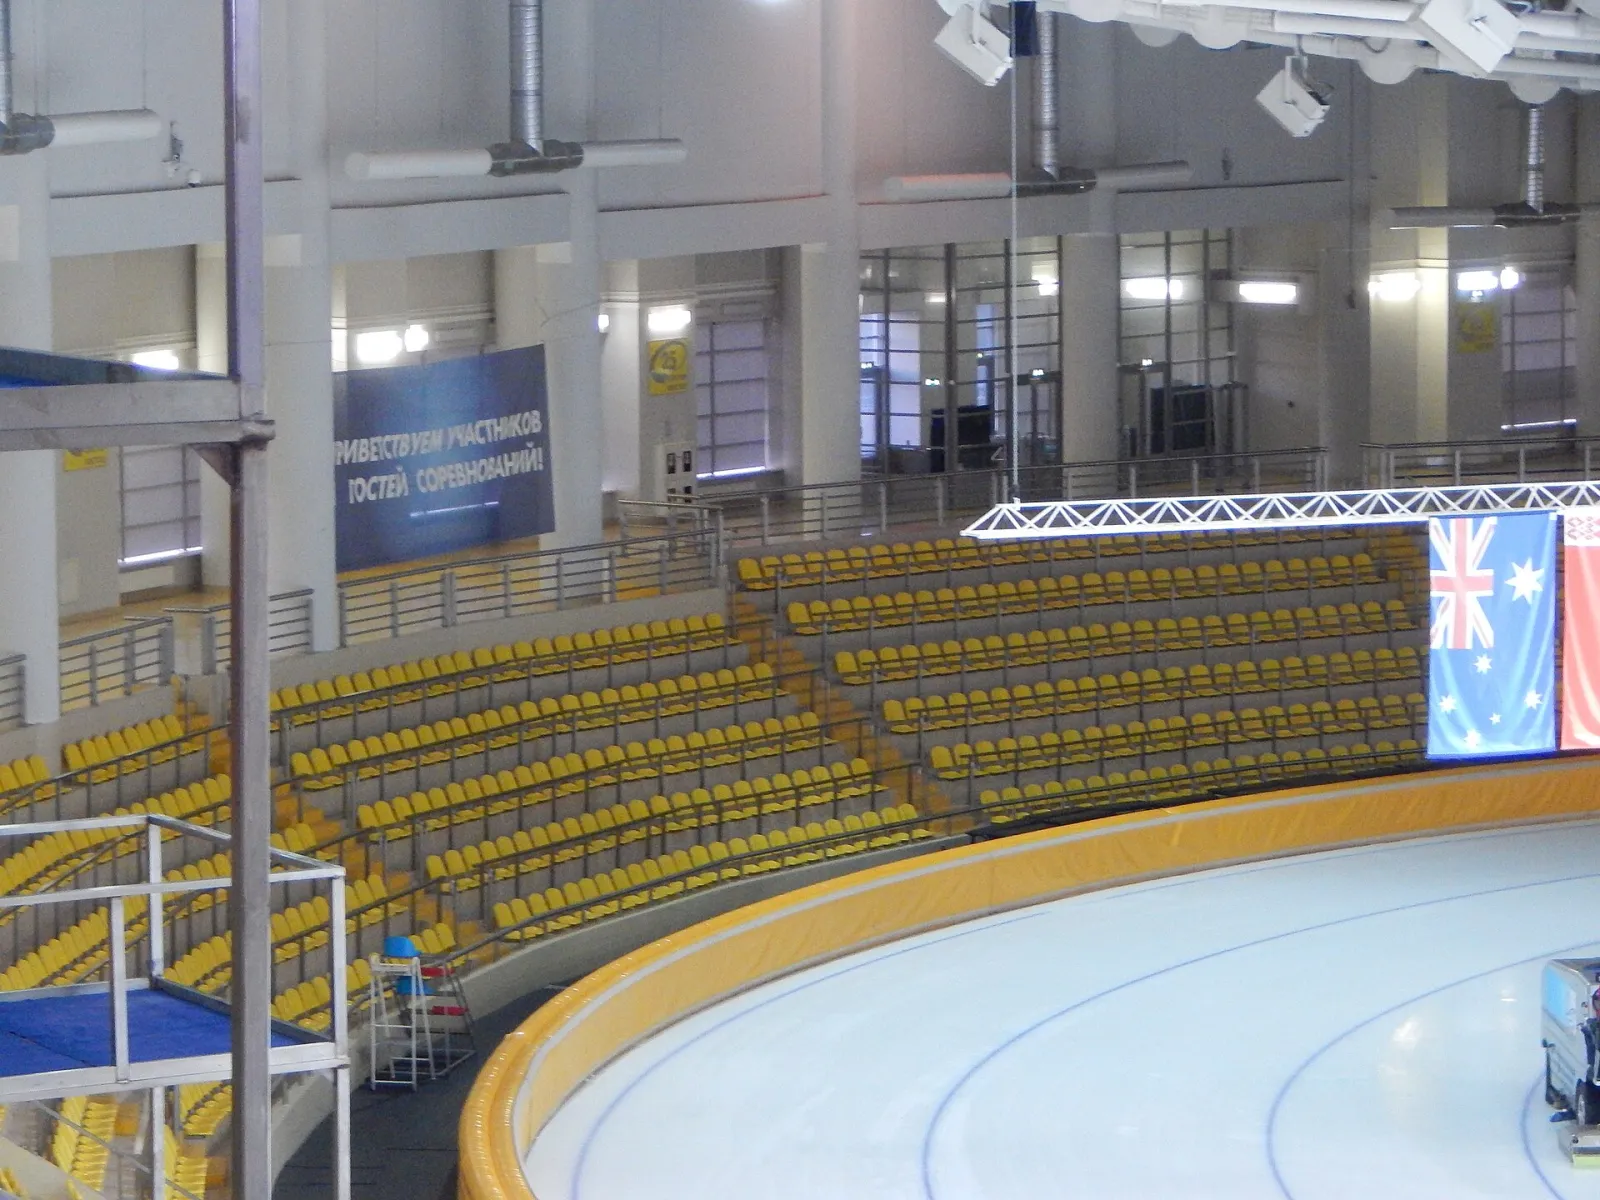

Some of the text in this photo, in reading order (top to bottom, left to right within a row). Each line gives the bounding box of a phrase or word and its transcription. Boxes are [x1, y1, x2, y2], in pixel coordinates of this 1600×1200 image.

[333, 410, 542, 465] РИВЕТСТВУЕМ УЧАСТНИКОВ
[348, 441, 544, 504] ГОСТЕЙ СОРЕВНОВАНИЙ!
